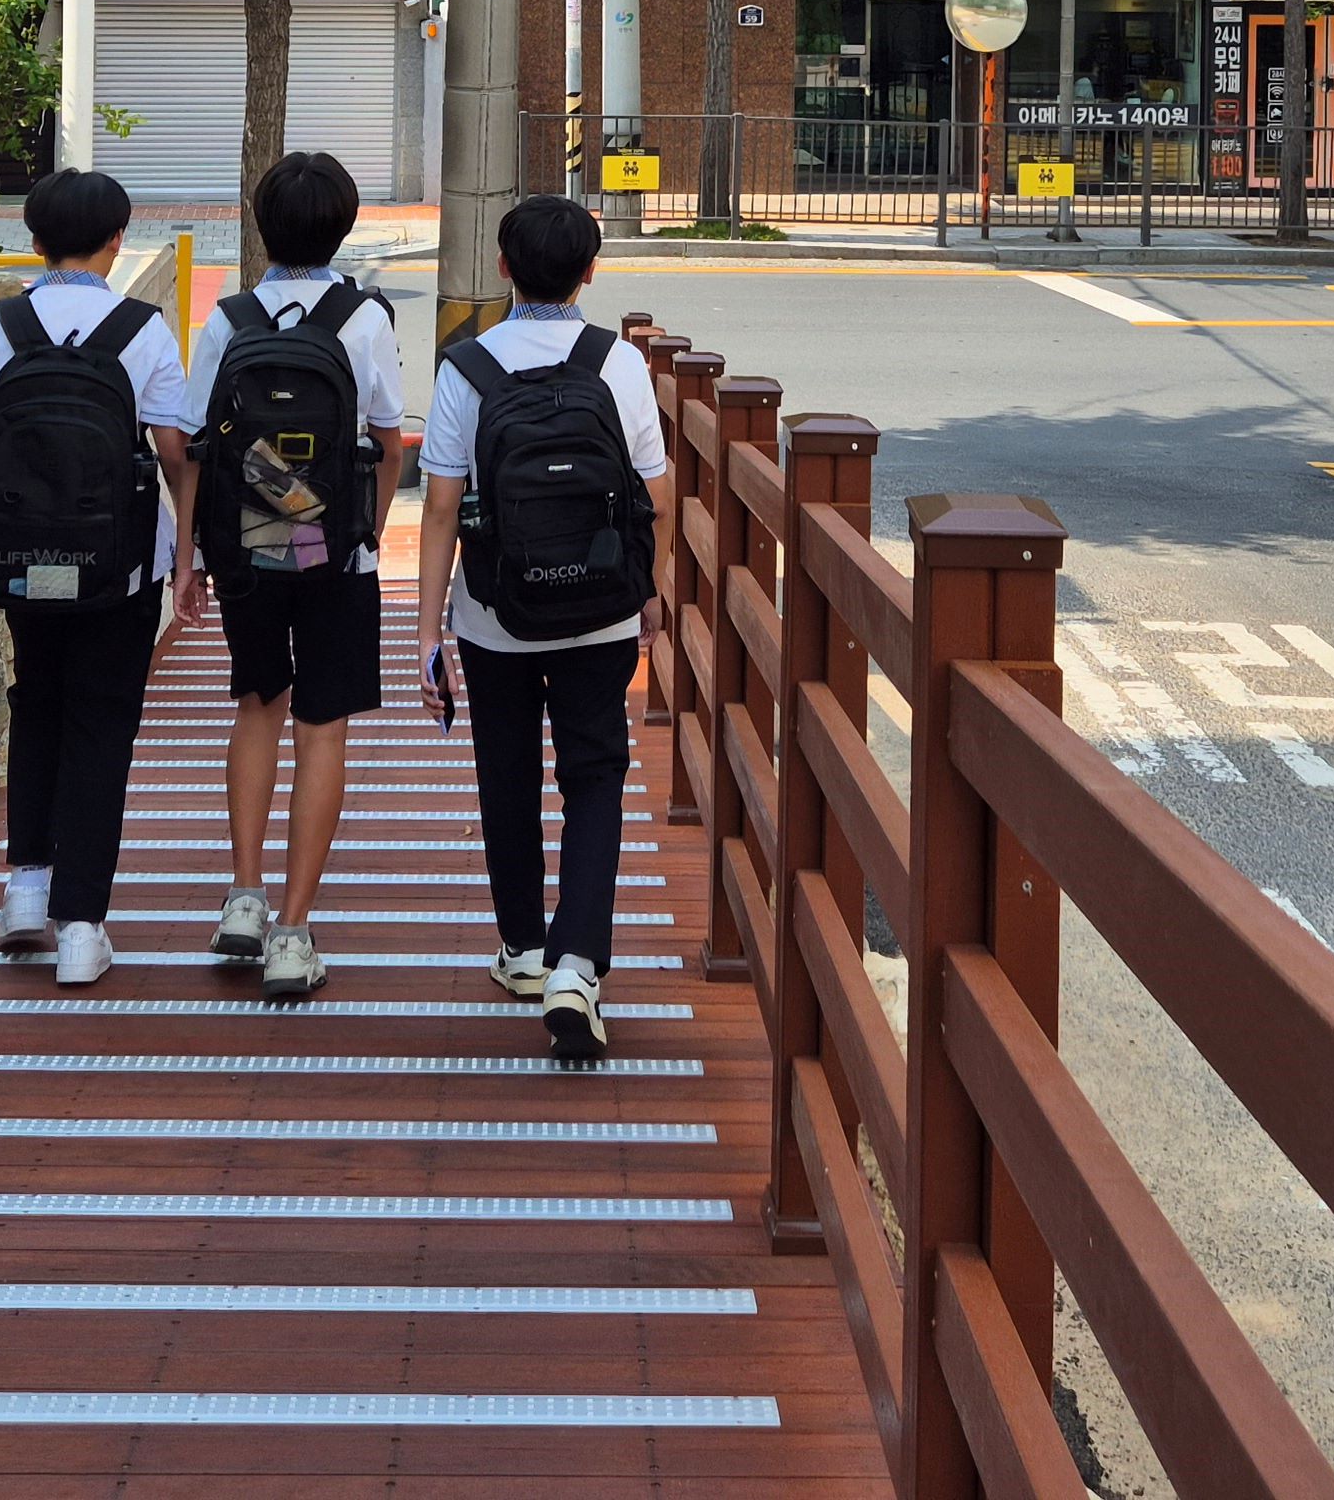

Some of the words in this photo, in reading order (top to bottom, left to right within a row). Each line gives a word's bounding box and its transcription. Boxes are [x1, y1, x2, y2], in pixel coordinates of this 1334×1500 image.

[745, 15, 758, 23] 59
[1214, 26, 1241, 44] 24시
[1214, 47, 1241, 70] 무인
[1214, 71, 1241, 93] 카페
[1118, 106, 1189, 127] 1400원
[530, 563, 588, 582] DISCOV
